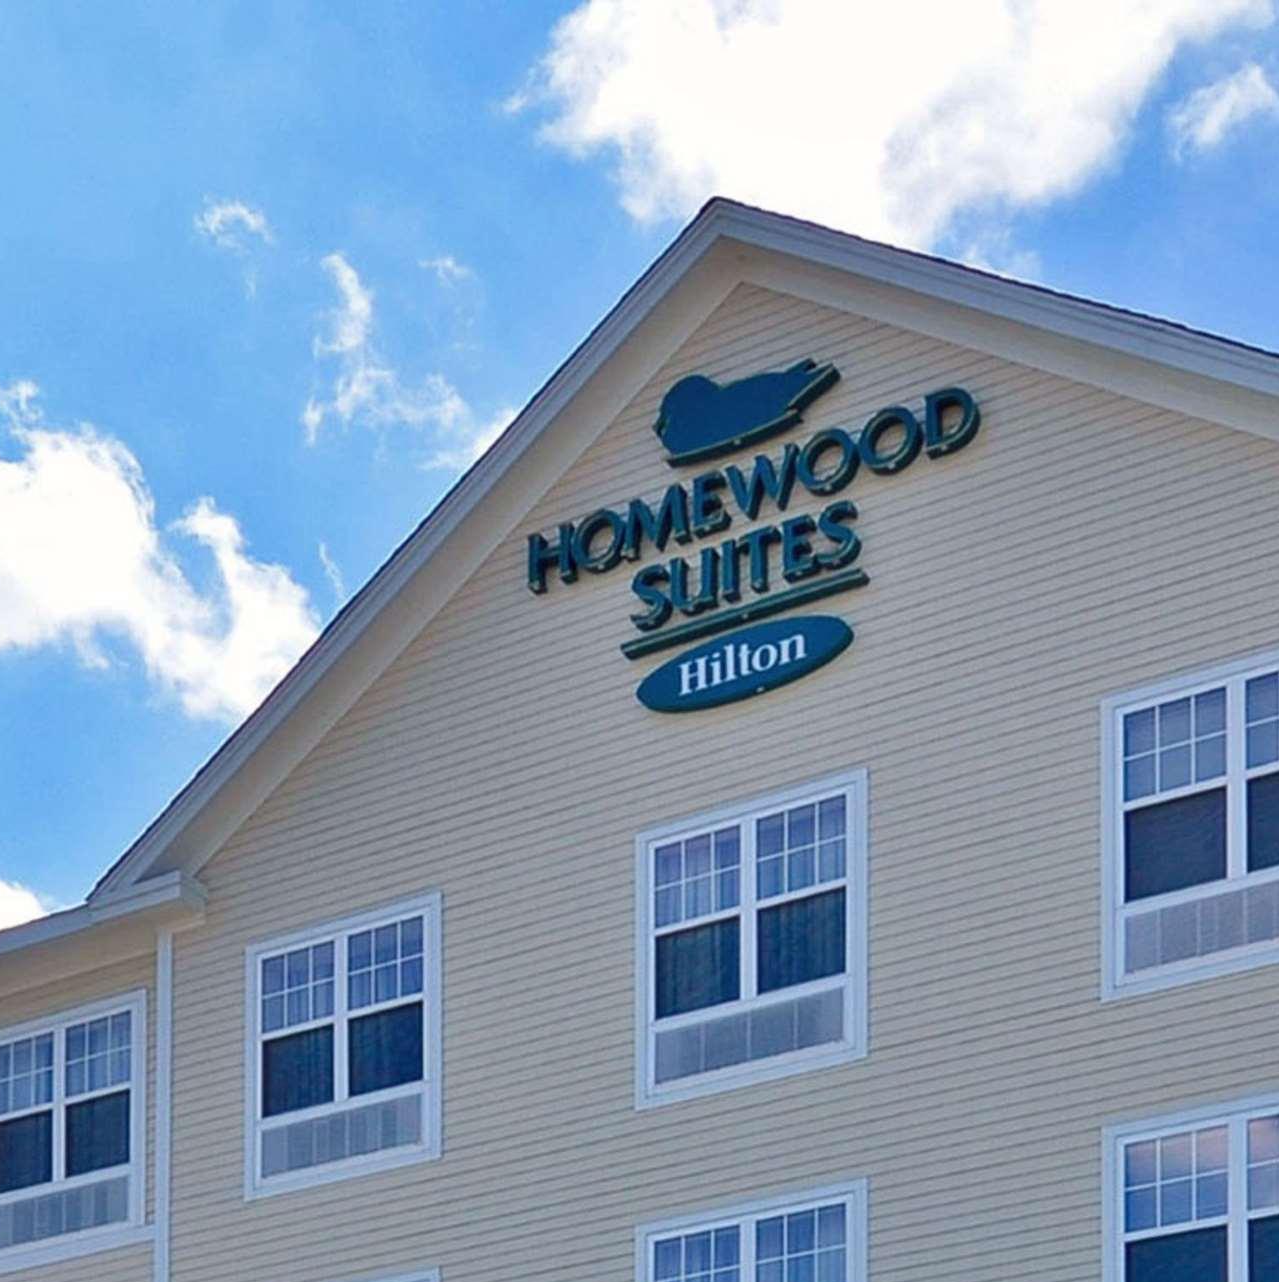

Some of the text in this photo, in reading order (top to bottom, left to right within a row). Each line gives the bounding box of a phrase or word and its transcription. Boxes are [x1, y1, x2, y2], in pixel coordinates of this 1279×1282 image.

[527, 386, 981, 595] HOMEWOOD
[630, 500, 862, 632] SUITES
[678, 634, 808, 696] Hilton
